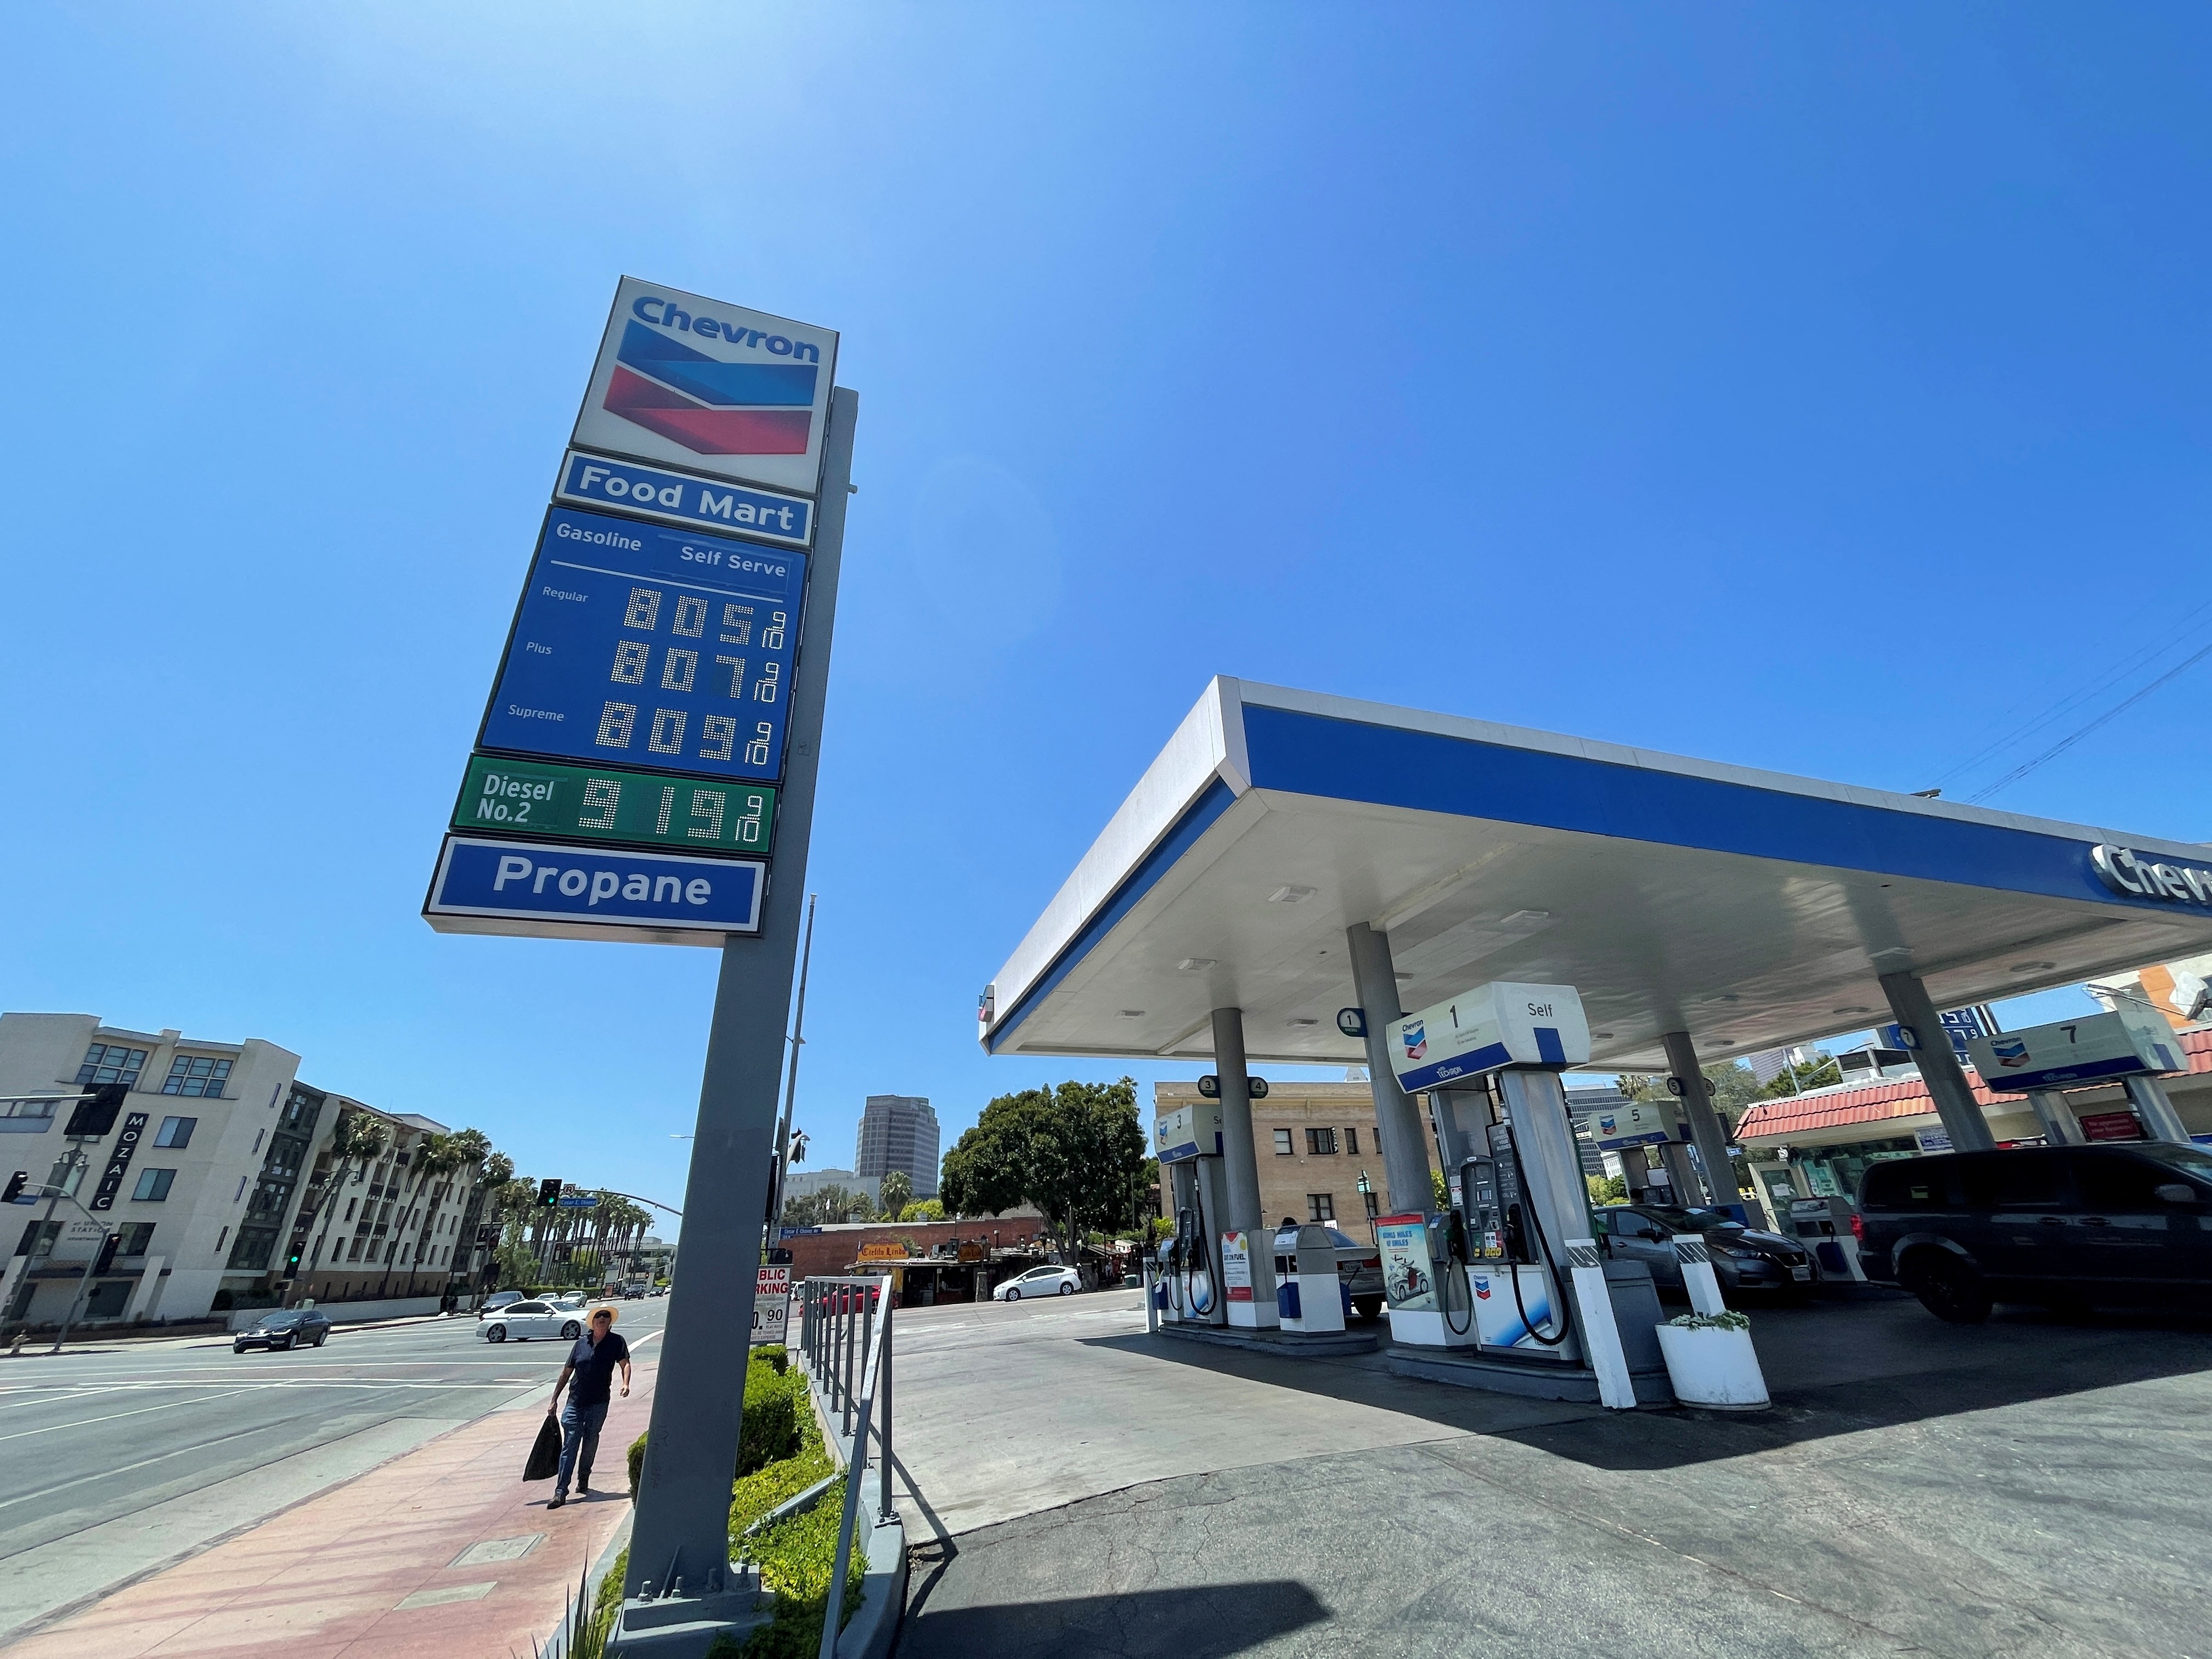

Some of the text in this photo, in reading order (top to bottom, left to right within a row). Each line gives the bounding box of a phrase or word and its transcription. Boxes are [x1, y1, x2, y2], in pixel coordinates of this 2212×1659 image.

[632, 296, 820, 363] Chevron
[580, 466, 794, 531] Food Mart
[556, 523, 642, 551] Gasoline
[680, 546, 786, 578] Self Serve
[542, 586, 589, 602] Regular
[526, 642, 552, 654] Plus
[508, 704, 565, 722] Supreme
[483, 774, 554, 801] Diesel
[477, 798, 531, 823] No.2
[493, 855, 712, 906] Propane
[1449, 1005, 1459, 1029] 1
[1527, 1003, 1553, 1018] Self
[1347, 1014, 1352, 1025] 1
[1402, 1019, 1424, 1033] Chevron
[2059, 1025, 2076, 1043] 7
[1990, 1037, 2022, 1047] Chevron
[1436, 1066, 1463, 1079] TECHRON
[1205, 1081, 1211, 1089] 3
[1255, 1082, 1261, 1090] 4
[1672, 1081, 1677, 1091] 5
[1177, 1114, 1182, 1129] 3
[1631, 1109, 1640, 1121] 5
[97, 1116, 144, 1207] MOZAIC
[758, 1269, 786, 1281] BLIC
